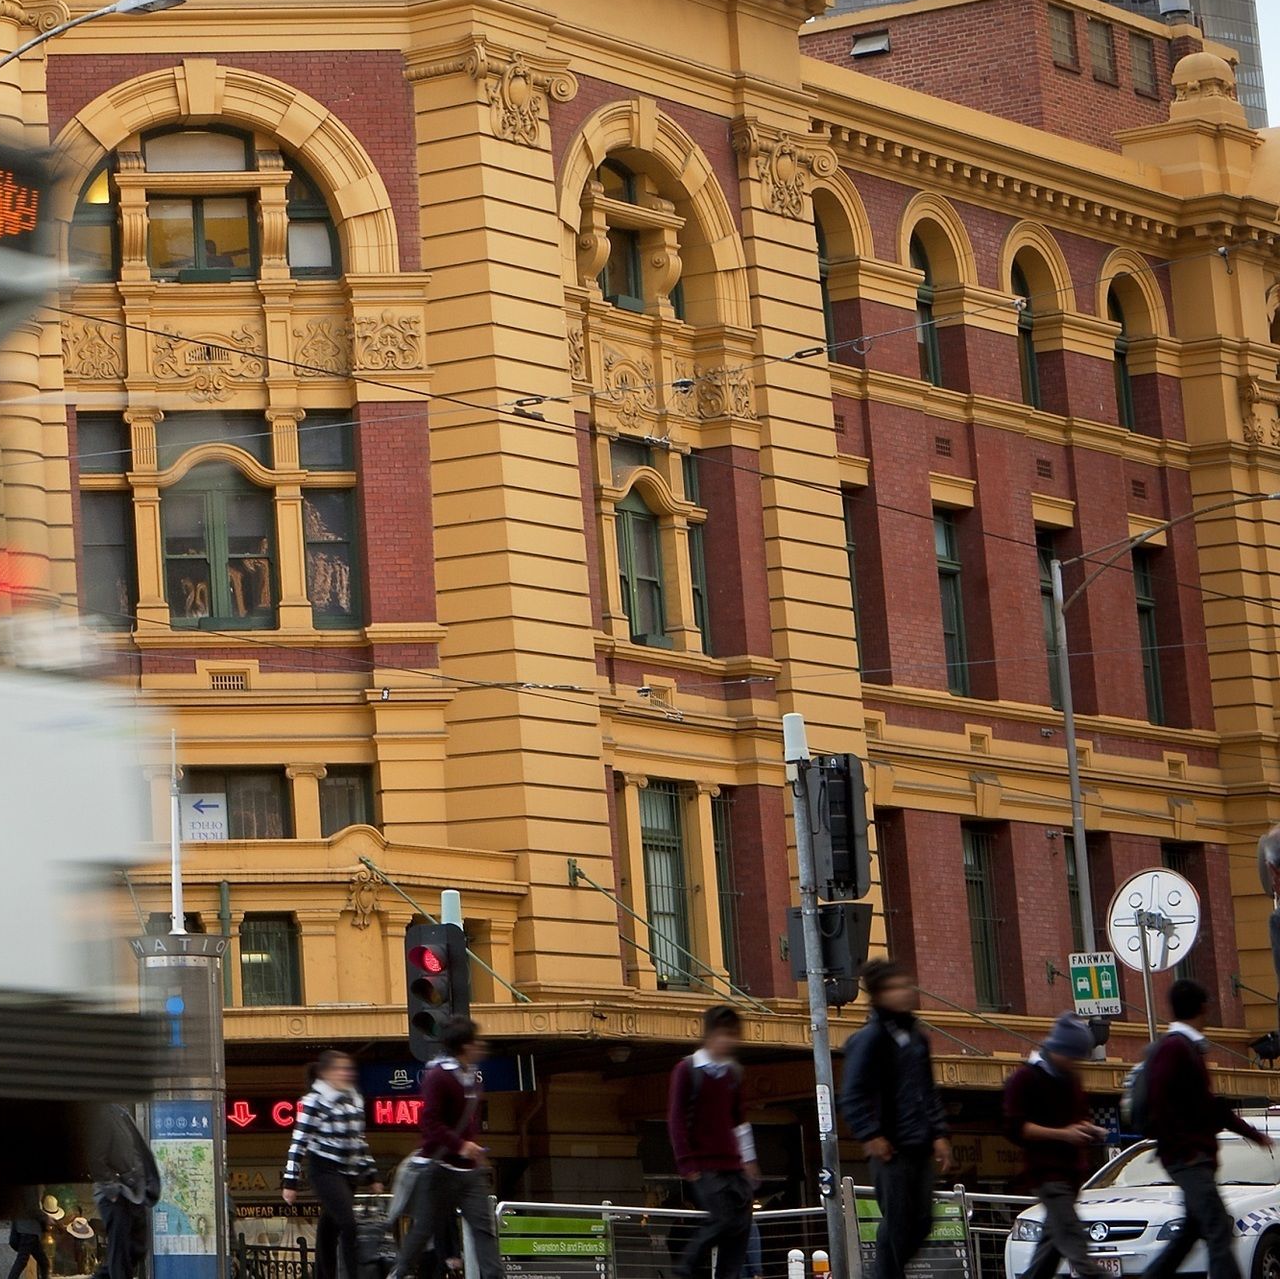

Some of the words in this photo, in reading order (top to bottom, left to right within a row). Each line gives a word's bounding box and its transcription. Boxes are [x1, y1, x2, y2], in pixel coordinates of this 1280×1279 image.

[1072, 954, 1111, 965] FAIRWAY
[1078, 1007, 1093, 1016] ALL
[1096, 1005, 1120, 1015] TIMES
[279, 1206, 298, 1216] FOR
